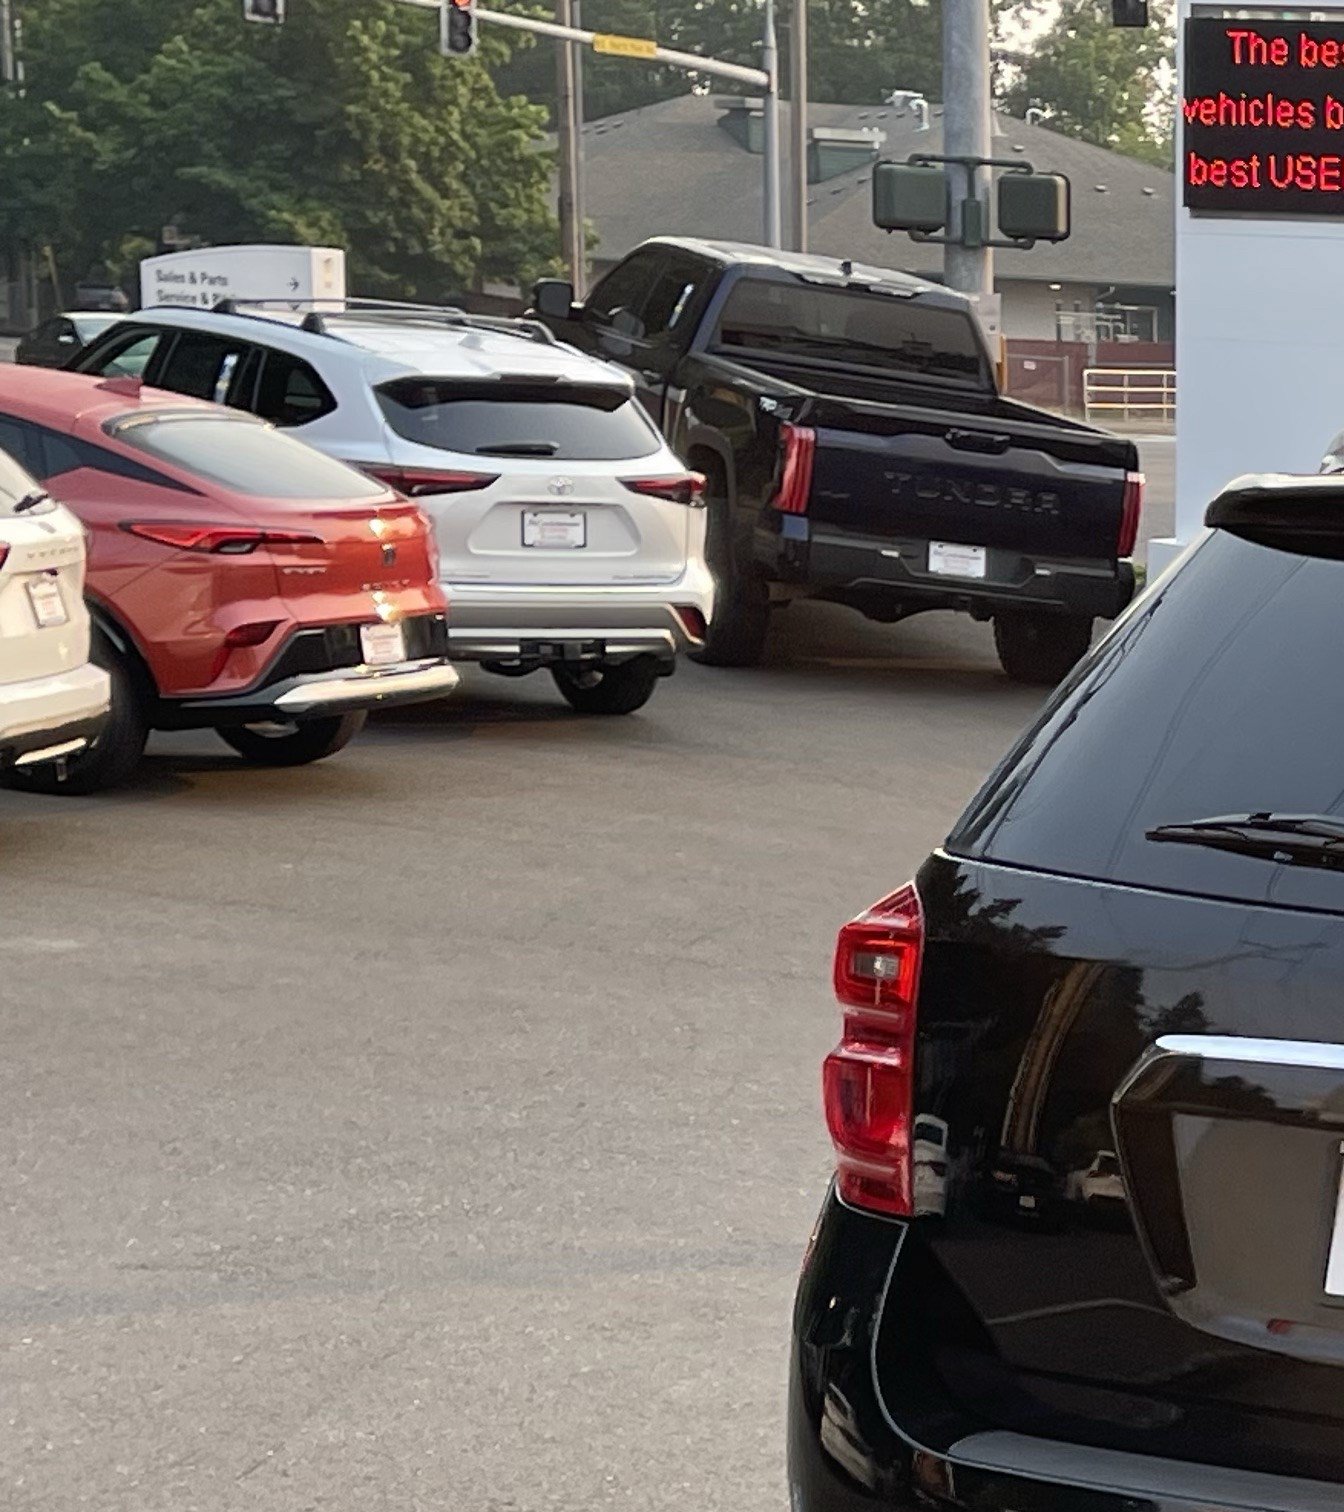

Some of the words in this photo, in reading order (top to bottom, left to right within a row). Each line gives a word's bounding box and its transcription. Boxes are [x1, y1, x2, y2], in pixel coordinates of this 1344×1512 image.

[1226, 29, 1289, 66] The
[1183, 91, 1316, 129] vehicles
[1189, 151, 1261, 188] best
[155, 269, 186, 284] Sales
[200, 271, 229, 286] Parts
[884, 471, 1059, 515] TUNDRA
